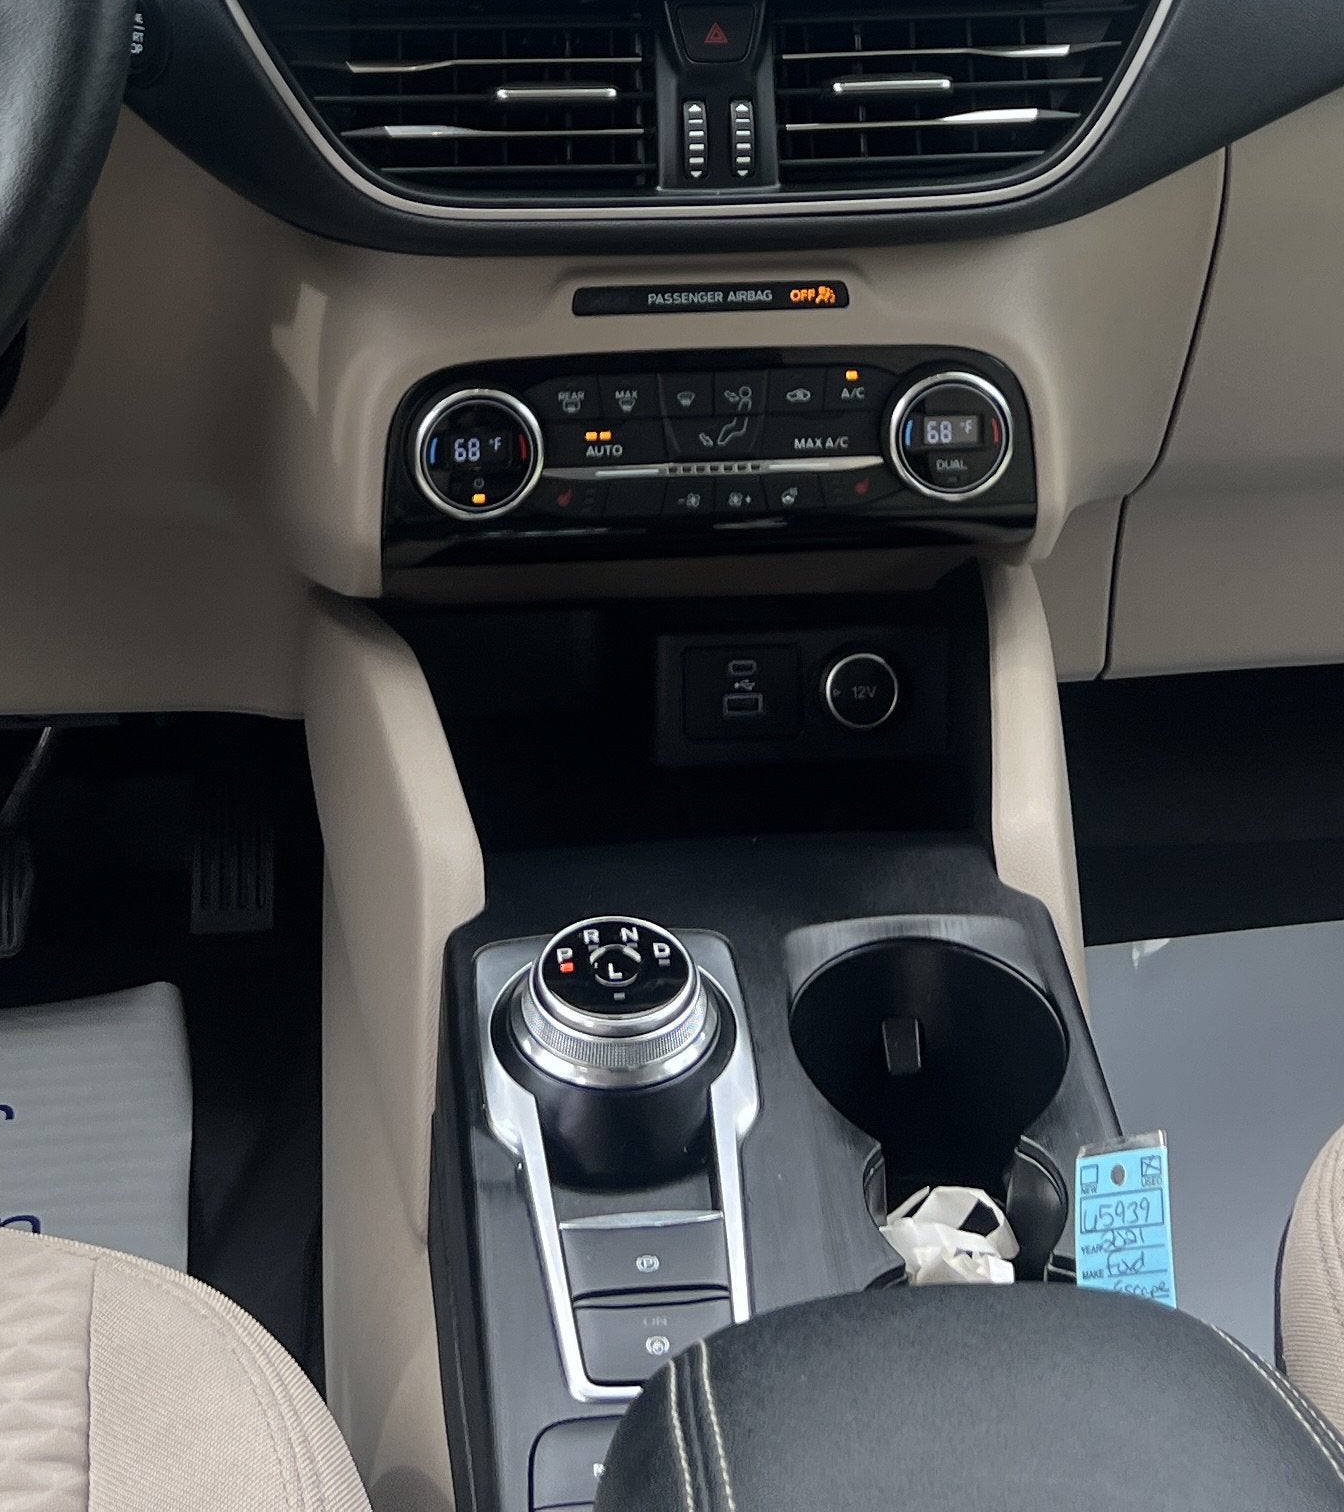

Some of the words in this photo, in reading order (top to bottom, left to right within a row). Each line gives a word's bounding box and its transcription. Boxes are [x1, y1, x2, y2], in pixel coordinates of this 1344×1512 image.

[647, 292, 723, 305] PASSENGER
[727, 289, 773, 303] AIRBAG
[789, 288, 816, 303] OFF
[558, 391, 585, 402] REAR
[615, 390, 638, 400] MAX
[840, 387, 865, 400] A/C
[926, 419, 953, 445] 68
[794, 438, 822, 450] MAX
[825, 436, 849, 449] A/C
[454, 437, 481, 463] 68
[585, 444, 623, 457] AUTO
[936, 458, 968, 471] DUAL
[851, 685, 877, 699] 12V
[557, 947, 574, 963] P
[583, 929, 600, 945] R
[620, 926, 639, 943] N
[652, 942, 671, 959] D
[608, 962, 623, 979] L
[1081, 1243, 1104, 1256] YEAR
[1082, 1268, 1104, 1280] MAKE
